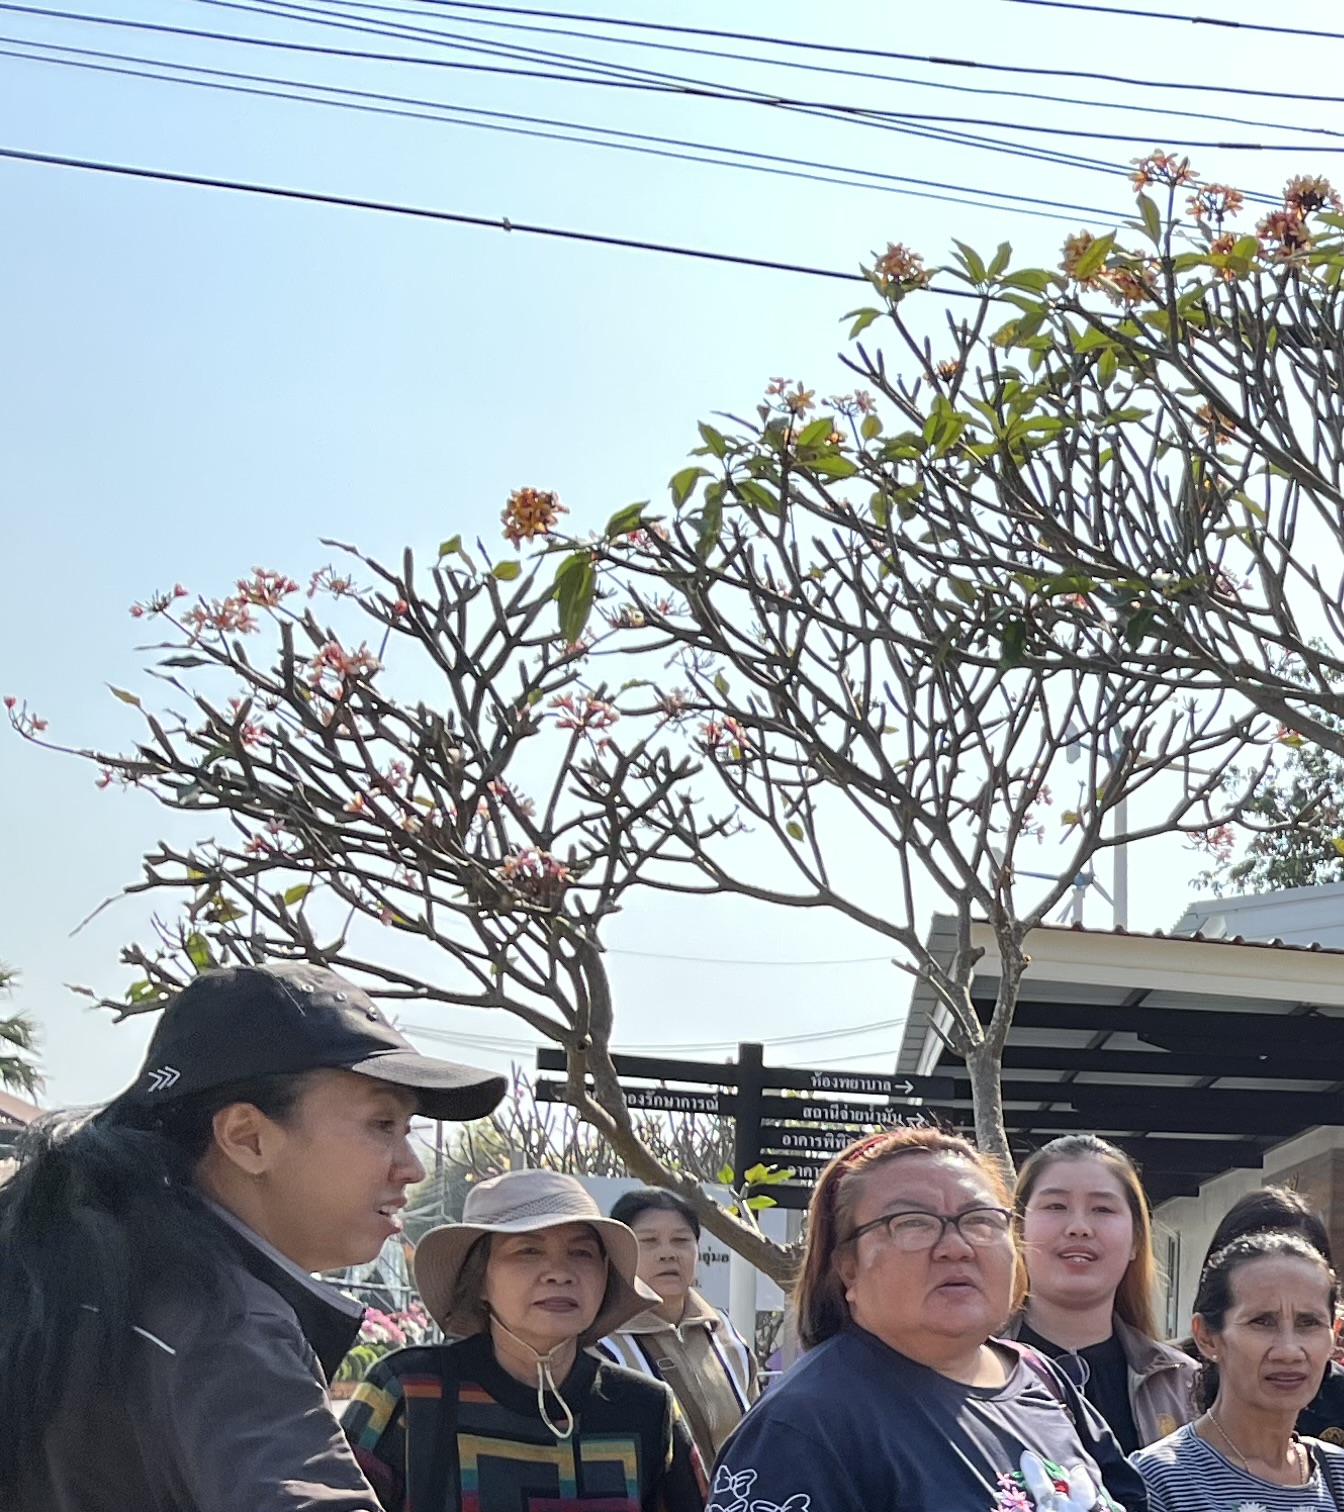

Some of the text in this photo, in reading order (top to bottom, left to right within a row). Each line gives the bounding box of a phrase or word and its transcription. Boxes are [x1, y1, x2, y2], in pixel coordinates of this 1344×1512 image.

[811, 1072, 891, 1092] ห้องพยาบาล
[621, 1090, 718, 1111] องรักษาการณ์
